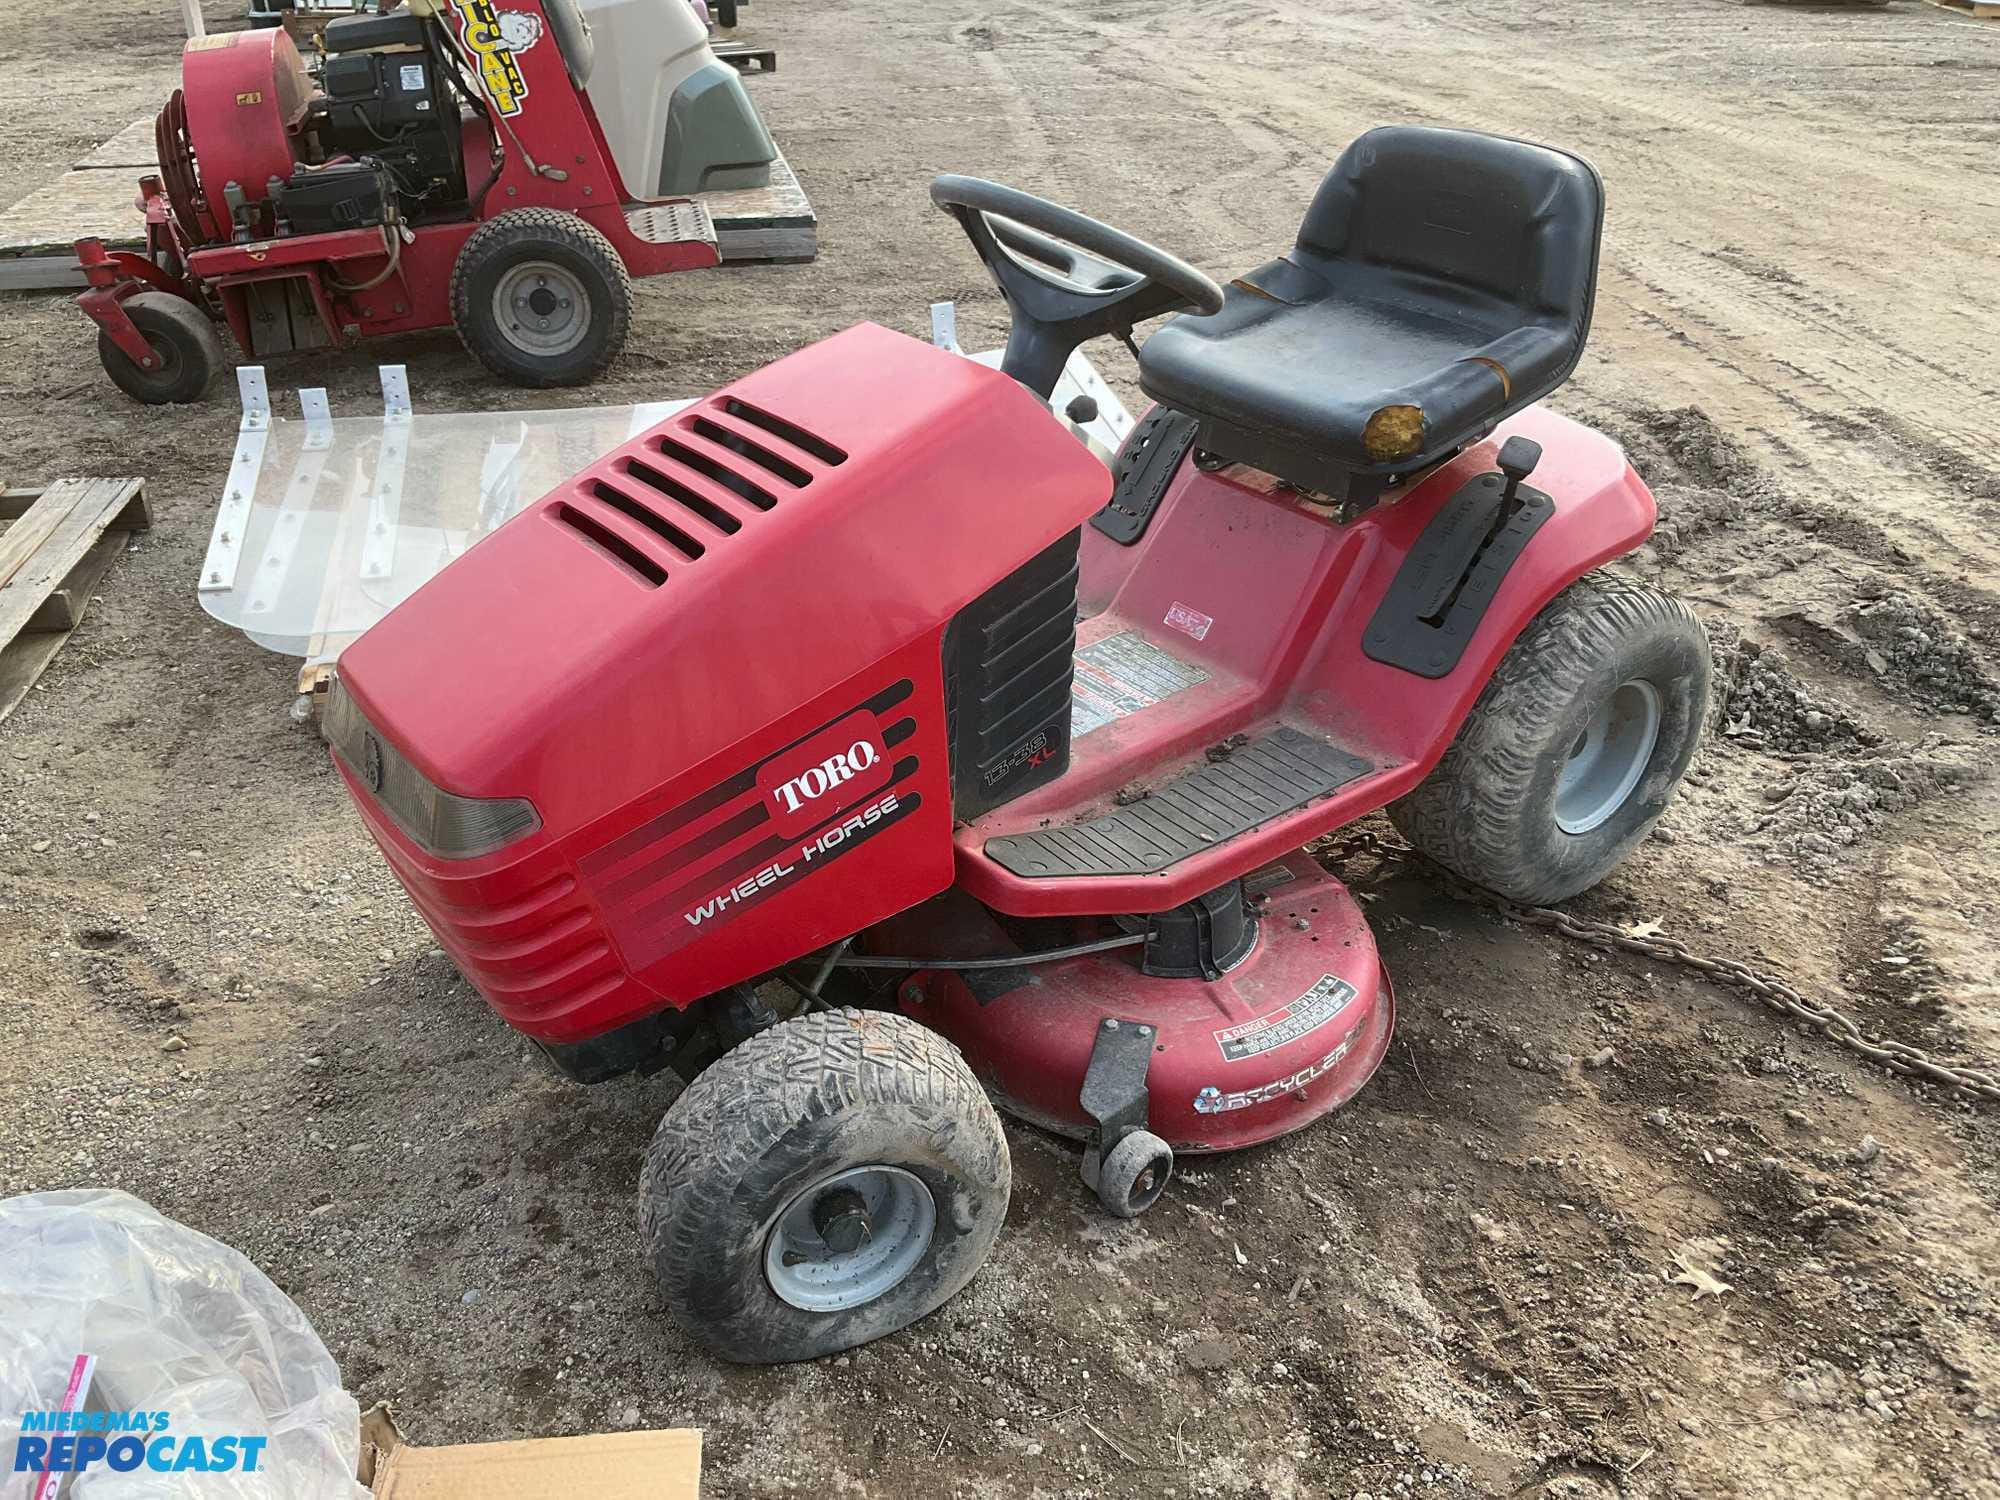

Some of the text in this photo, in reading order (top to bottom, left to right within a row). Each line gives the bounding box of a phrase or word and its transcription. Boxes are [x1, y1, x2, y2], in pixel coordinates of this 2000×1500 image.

[500, 51, 524, 95] VAC
[774, 740, 875, 813] TORO
[1027, 747, 1056, 769] XL
[684, 793, 900, 926] WHEEL HORSE
[1232, 1019, 1271, 1038] DANGER
